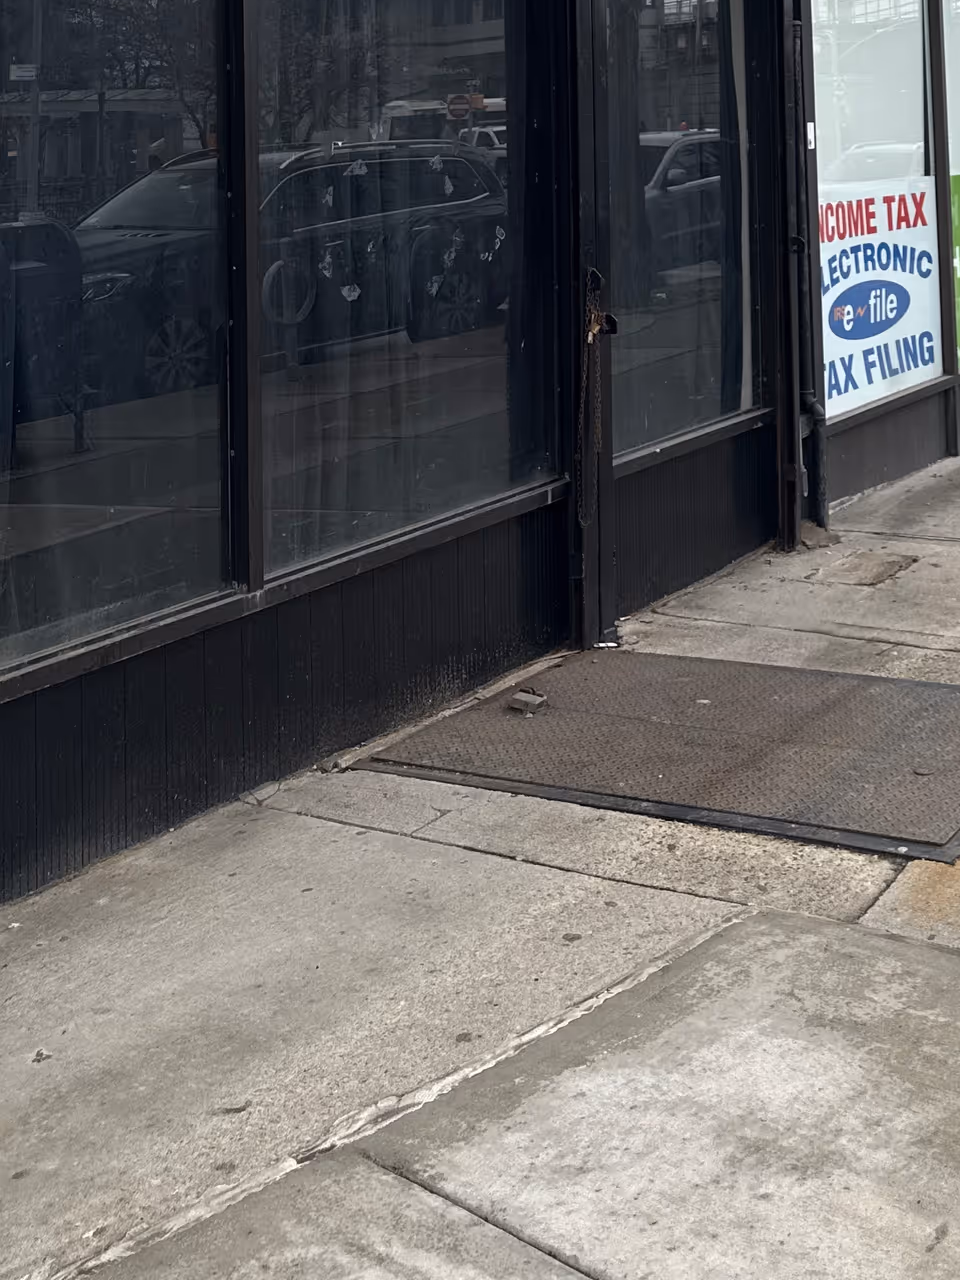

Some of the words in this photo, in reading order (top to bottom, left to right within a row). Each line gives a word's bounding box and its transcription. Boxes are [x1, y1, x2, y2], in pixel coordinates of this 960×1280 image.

[819, 197, 877, 243] NCOME
[882, 192, 928, 232] TAX
[820, 242, 934, 297] LECTRONIC
[823, 353, 860, 401] AX
[862, 330, 935, 386] FILING
